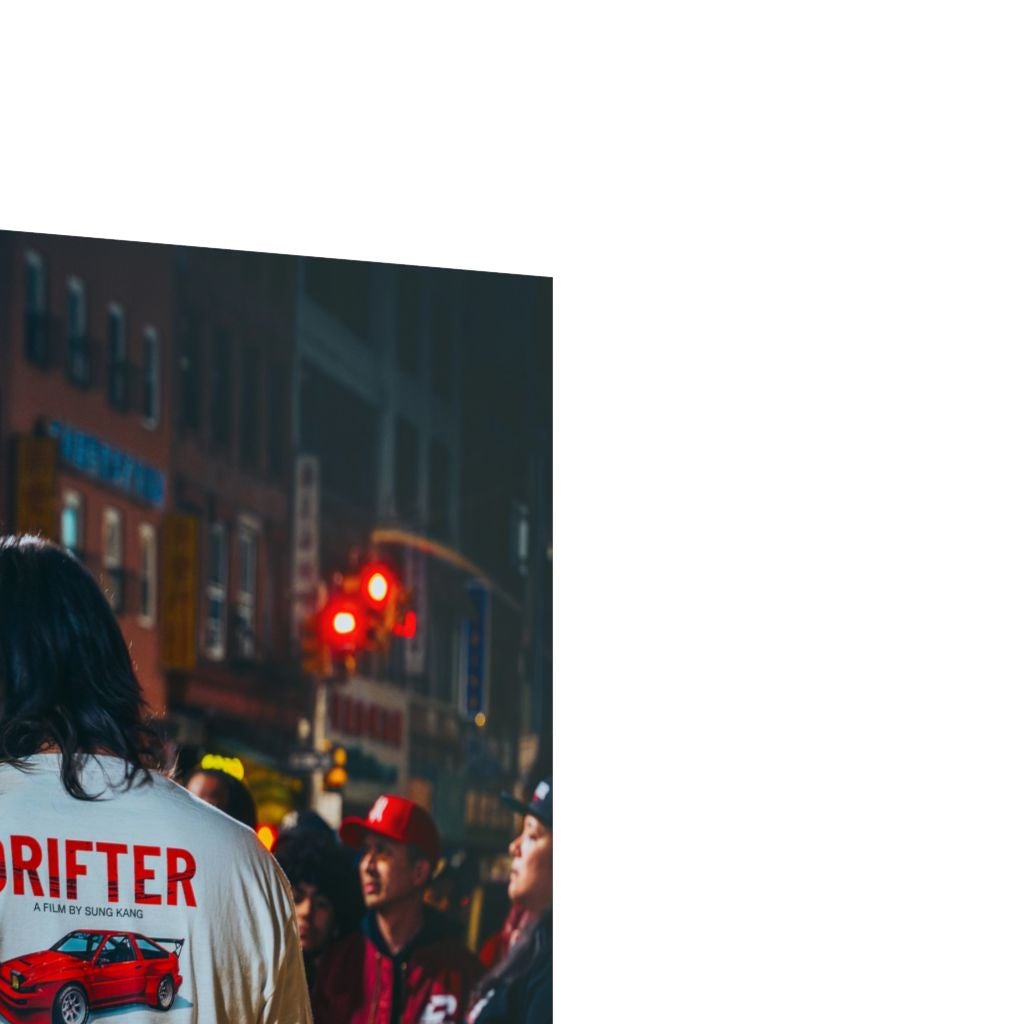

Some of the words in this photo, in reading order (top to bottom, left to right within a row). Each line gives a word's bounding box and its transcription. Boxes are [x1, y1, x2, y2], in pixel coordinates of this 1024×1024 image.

[33, 902, 42, 912] A
[43, 903, 67, 915] FILM
[69, 905, 82, 916] BY
[85, 906, 114, 918] SUNG
[116, 908, 144, 919] KANG
